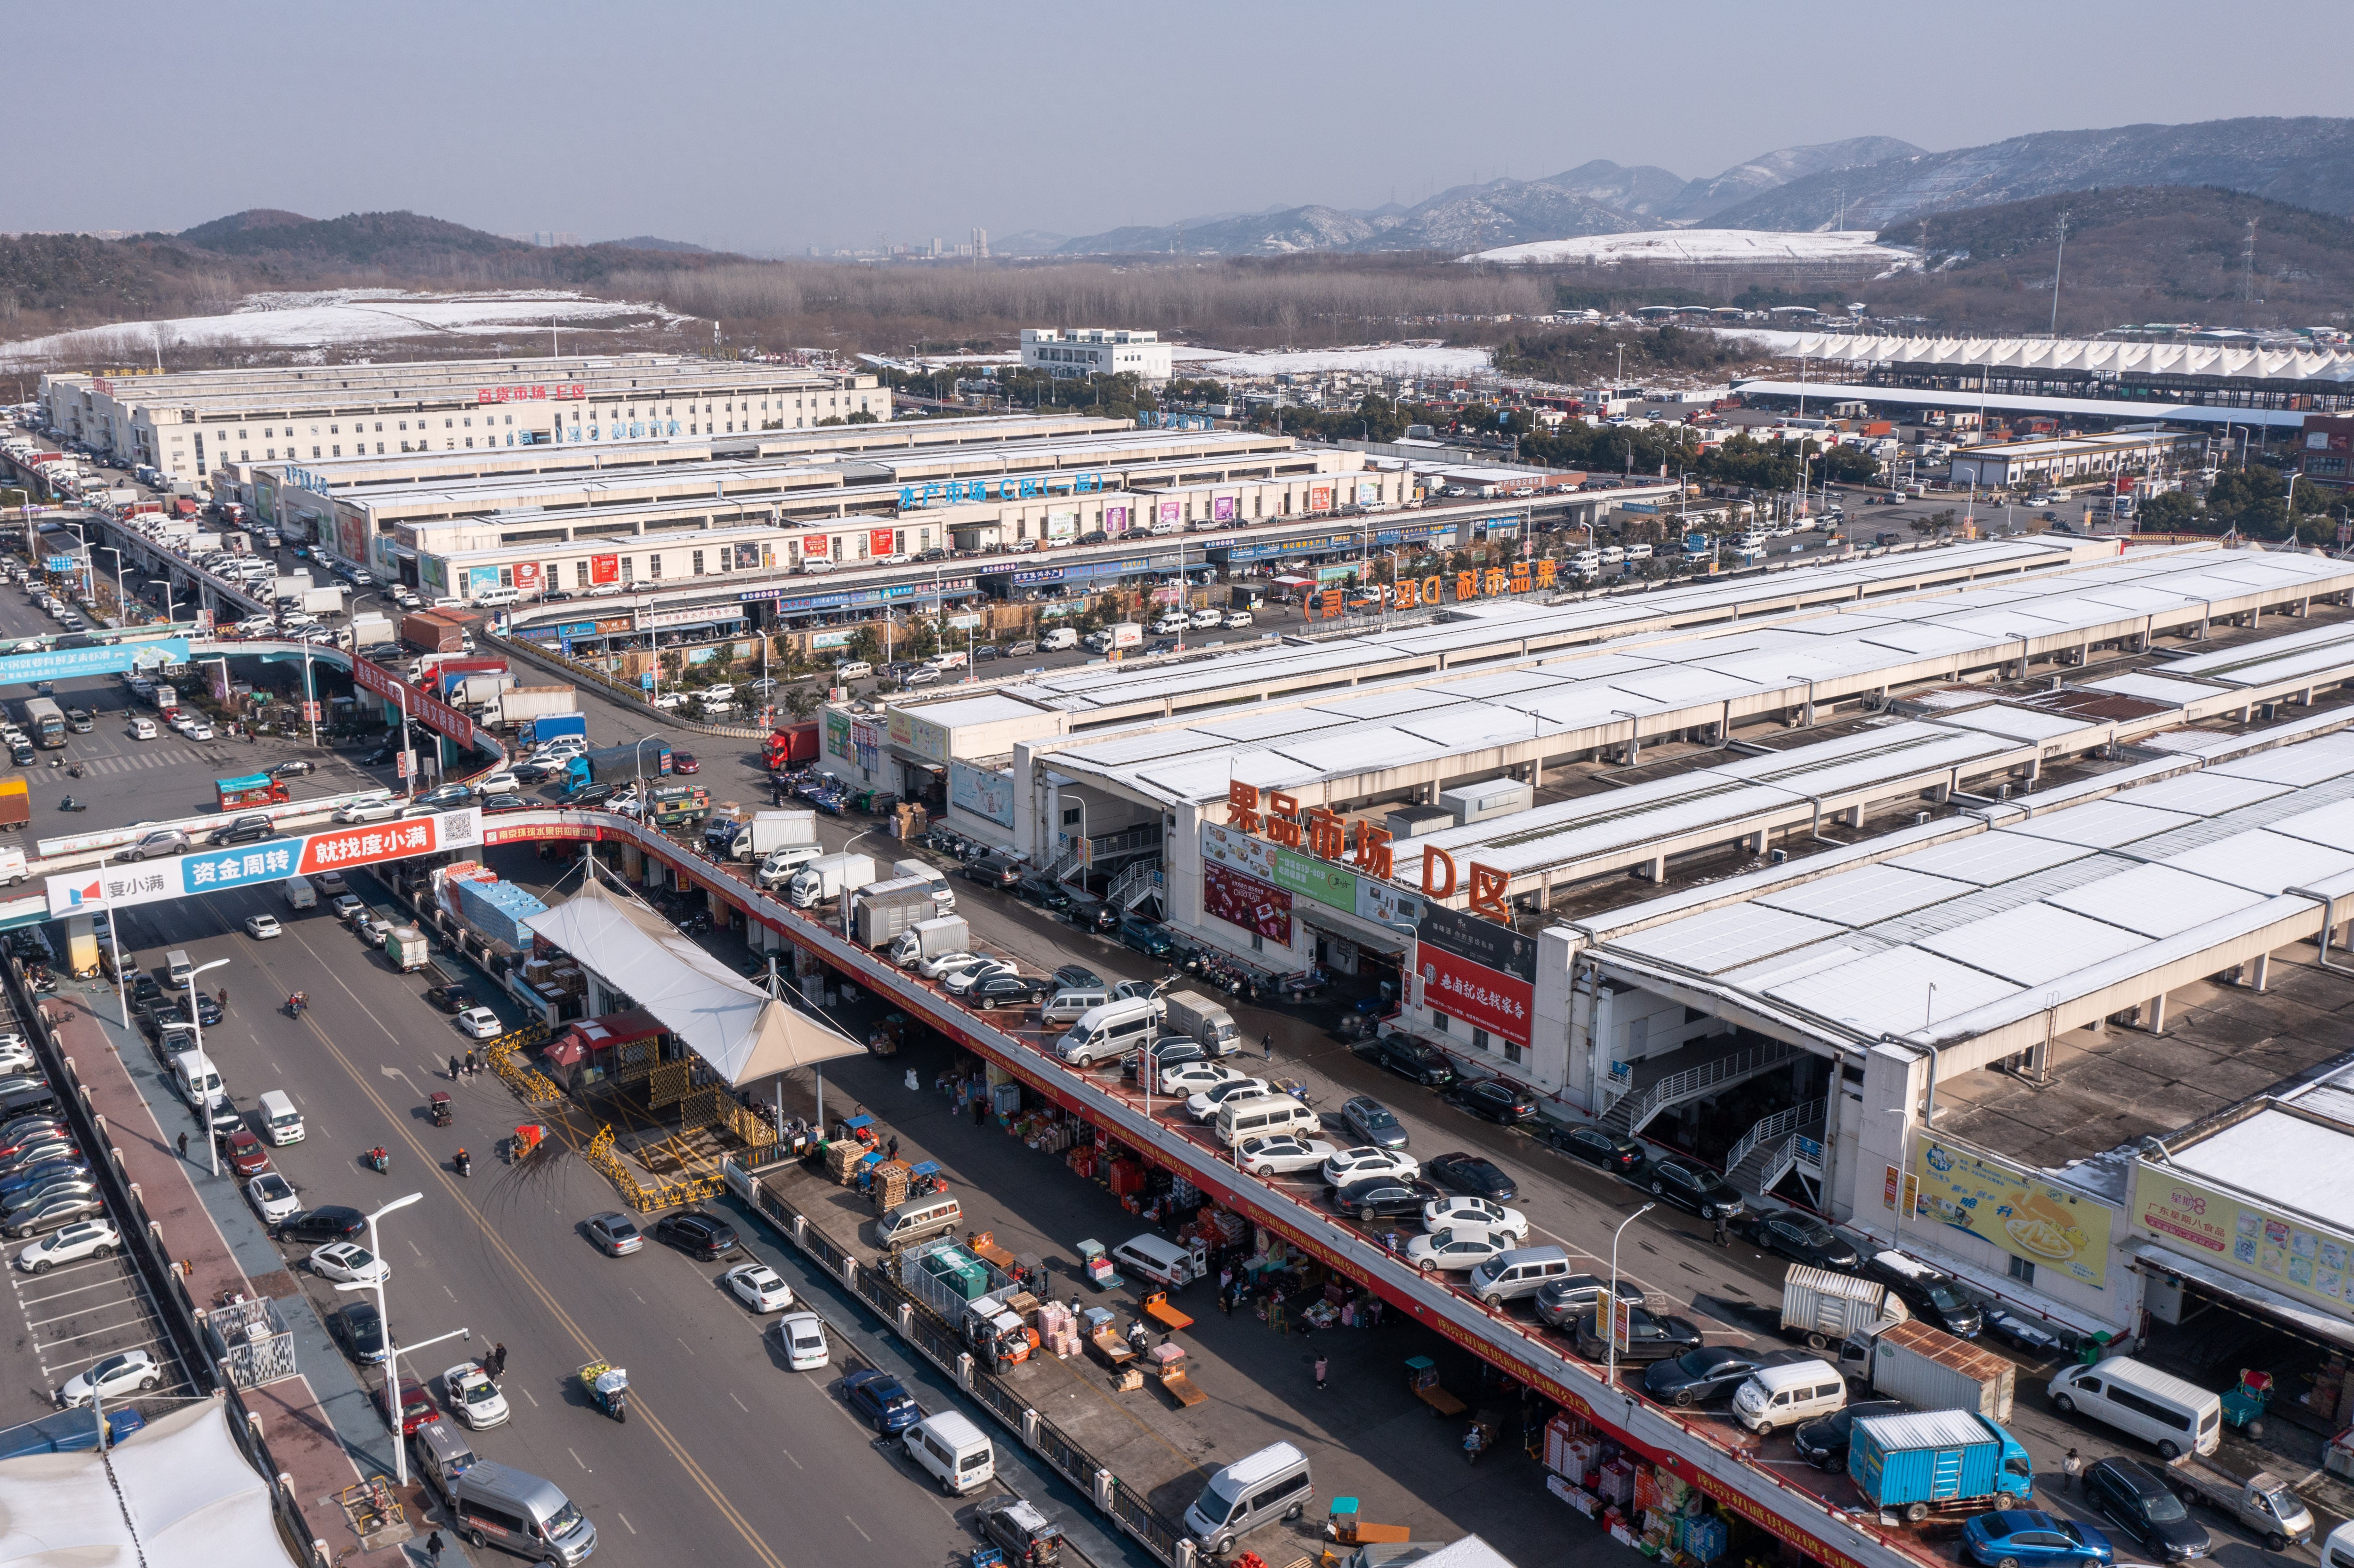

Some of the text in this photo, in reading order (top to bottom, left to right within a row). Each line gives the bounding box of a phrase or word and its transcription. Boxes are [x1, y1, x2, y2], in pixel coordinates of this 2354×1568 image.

[477, 384, 586, 403] 百货市场 E区
[898, 480, 985, 509] 水产市场
[1498, 477, 1540, 488] 水产综合交易区
[1282, 539, 1327, 549] 林记海鲜水产行
[358, 661, 466, 741] 增强卫生观念 提高文明意识
[315, 826, 427, 864] 就找度小满
[499, 826, 597, 839] 南京环球水果供应链中心
[192, 849, 289, 886] 资金周转
[1227, 779, 1511, 924] 果品市场 D区
[107, 874, 164, 898] 度小满
[1233, 888, 1261, 903] CHOCOLATE
[1440, 972, 1525, 1020] 老卤就选钱家香
[2148, 1202, 2225, 1238] 广东星期八食品
[1247, 1204, 1369, 1283] 南京初诚供应链有限公司
[1437, 1317, 1590, 1416] 南京初诚供应链有限公司
